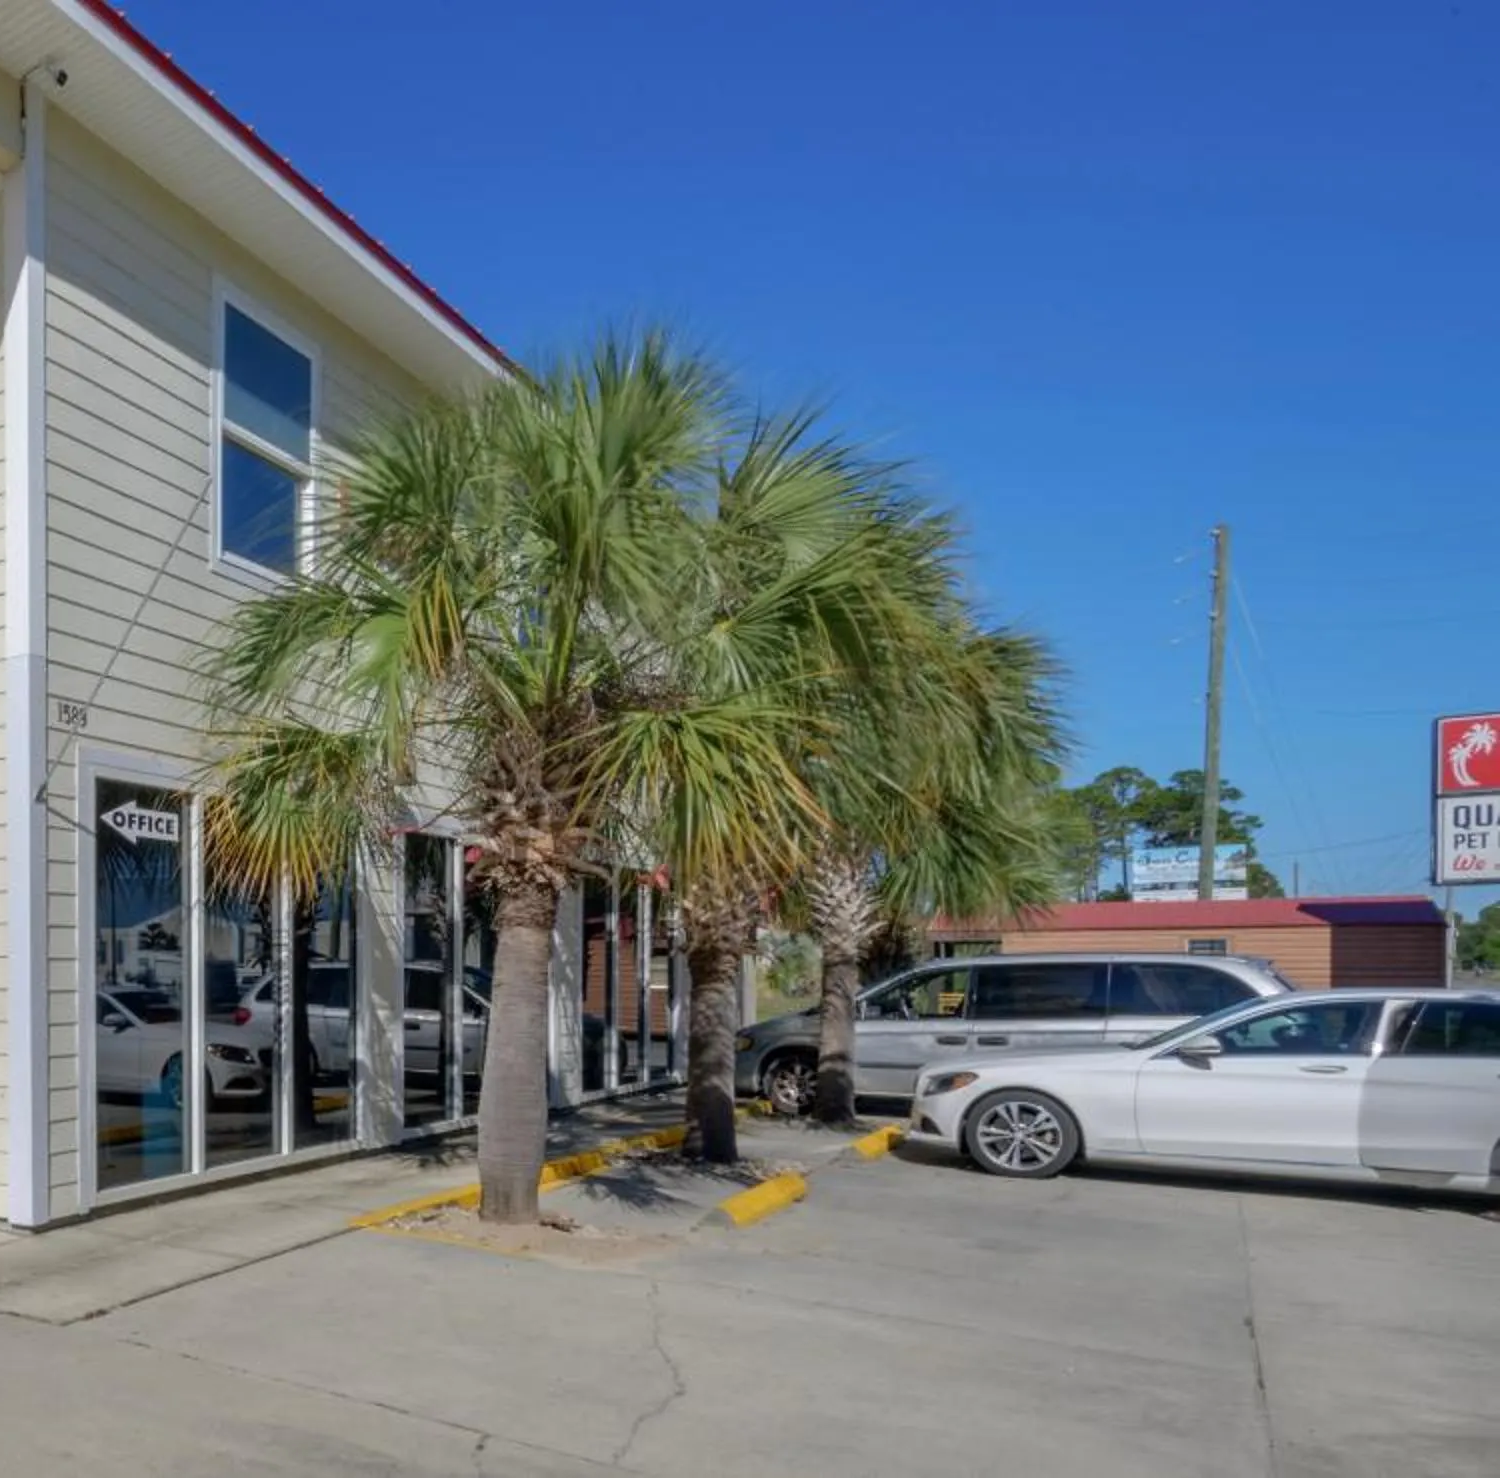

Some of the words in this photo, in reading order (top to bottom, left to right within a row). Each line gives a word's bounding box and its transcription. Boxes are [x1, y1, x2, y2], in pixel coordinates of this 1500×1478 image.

[112, 811, 175, 834] OFFICE
[1453, 803, 1500, 830] QU
[1453, 831, 1490, 850] PET
